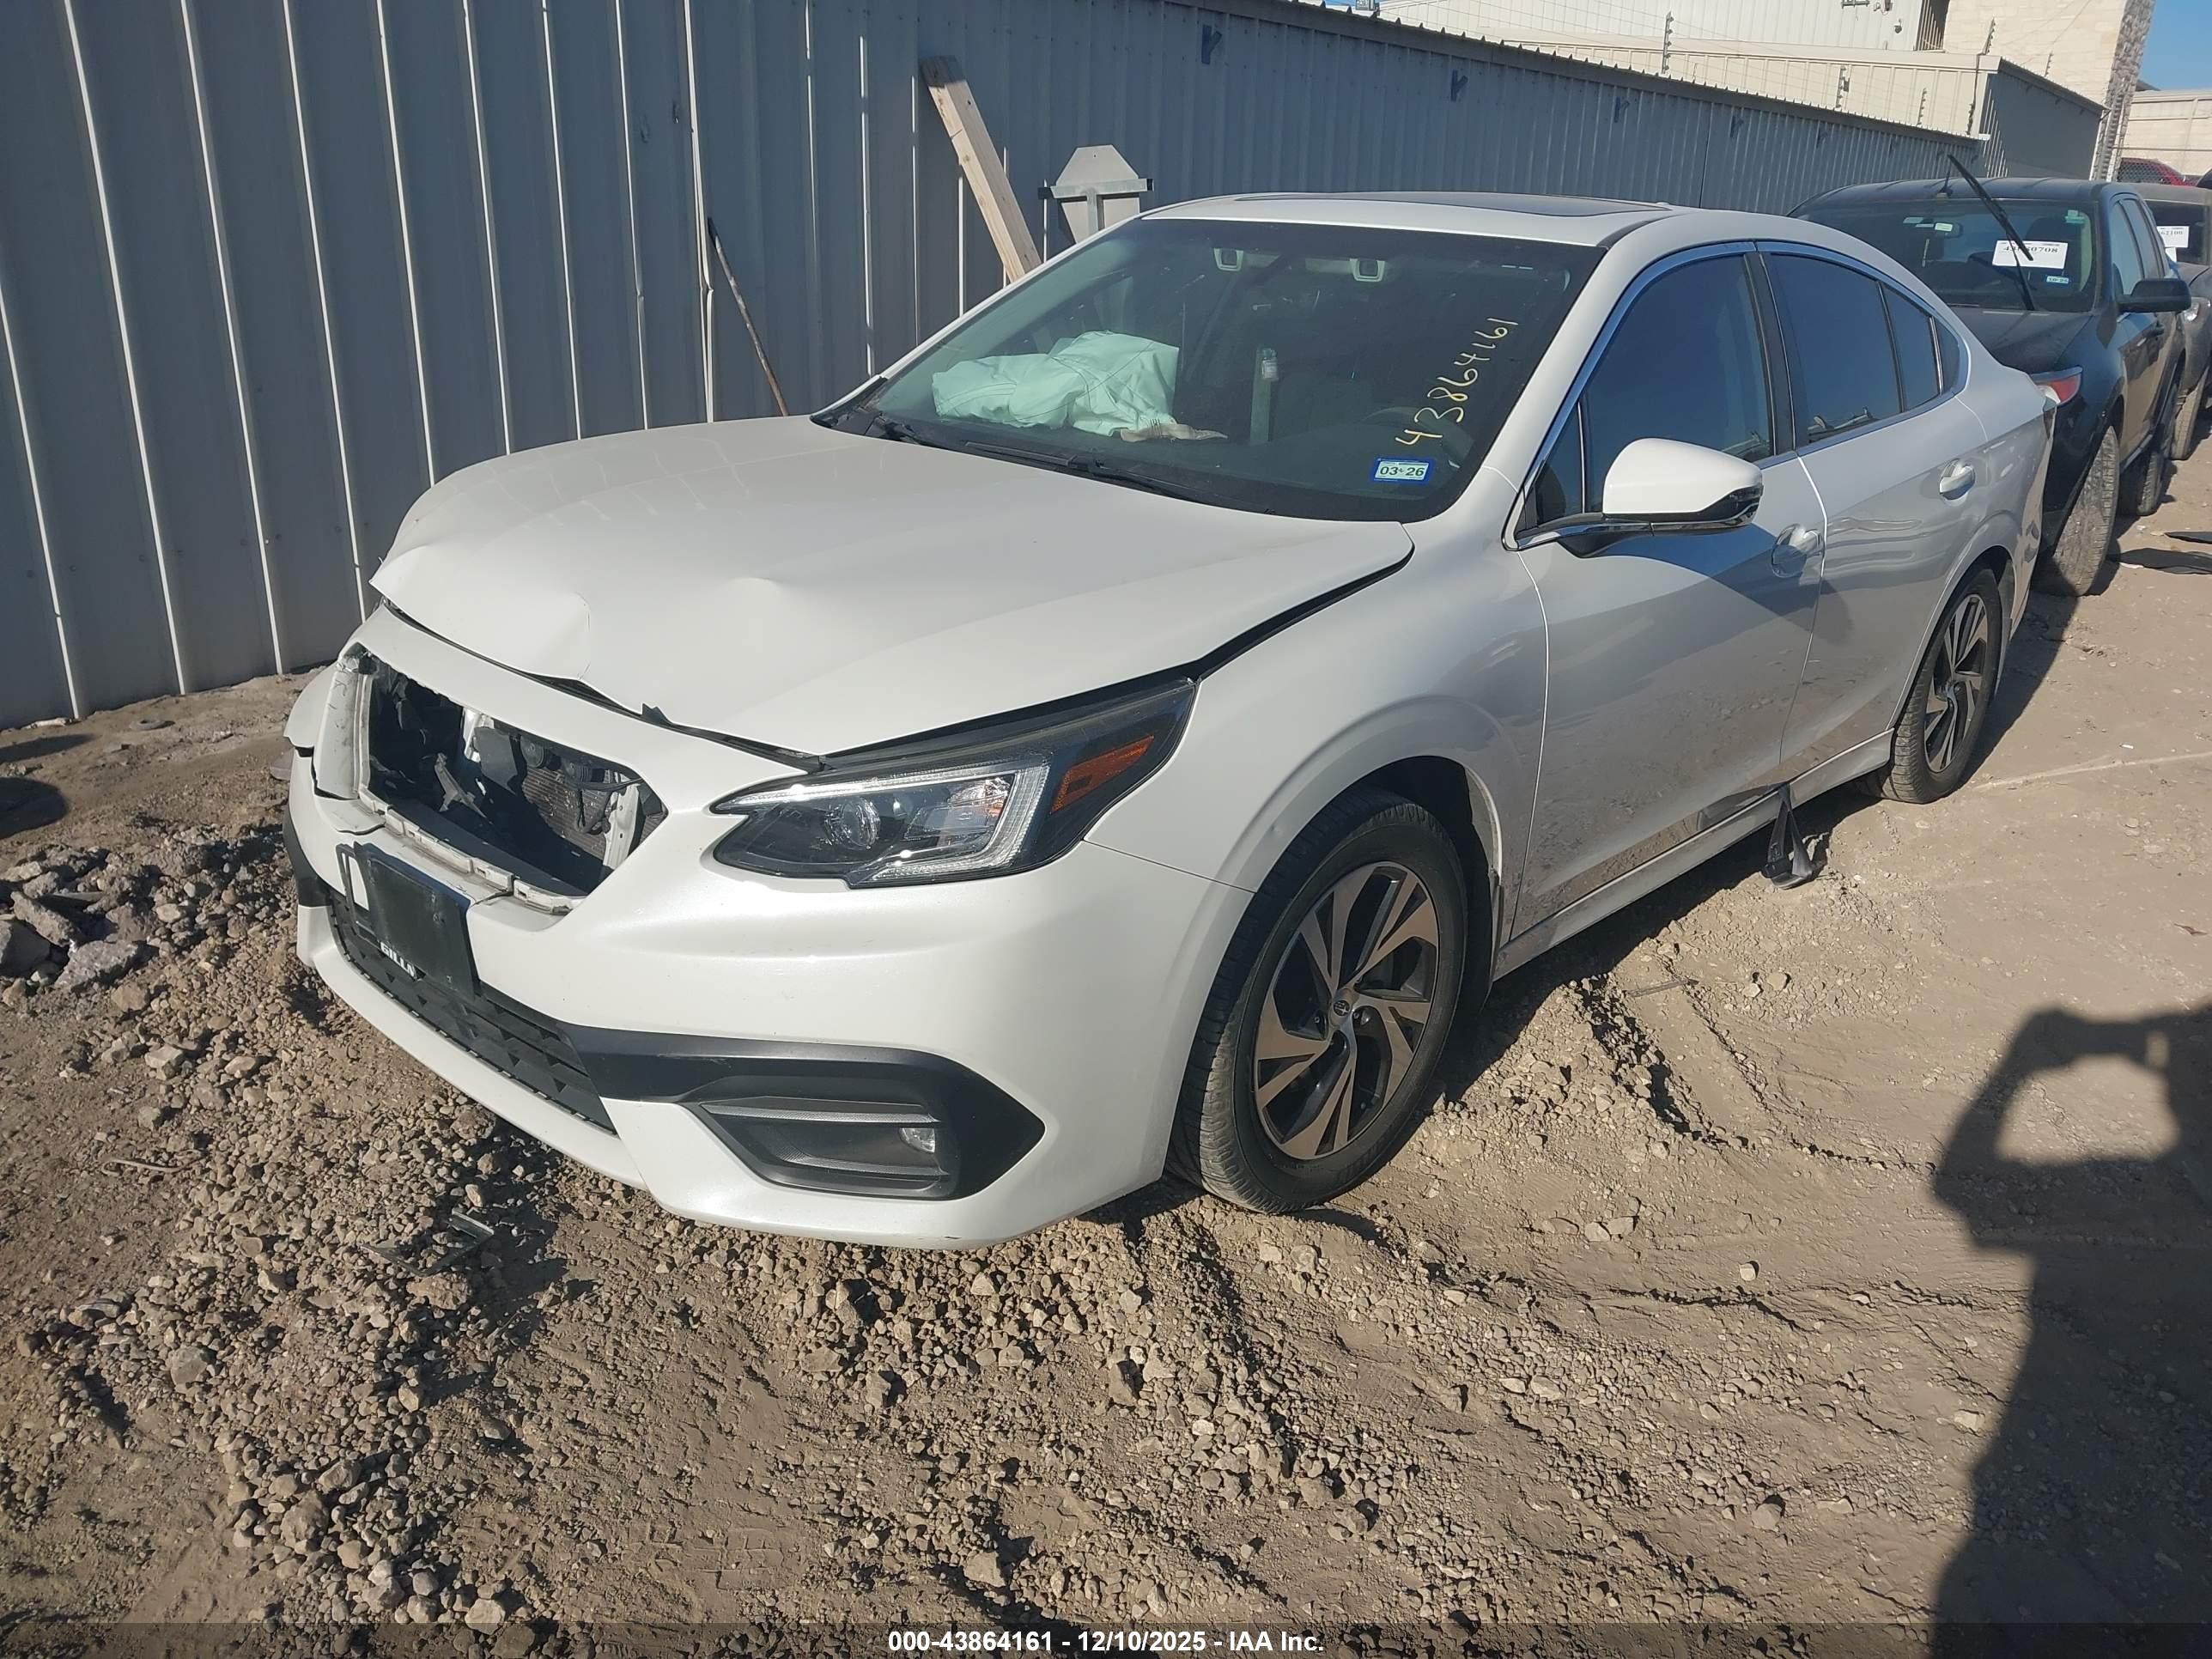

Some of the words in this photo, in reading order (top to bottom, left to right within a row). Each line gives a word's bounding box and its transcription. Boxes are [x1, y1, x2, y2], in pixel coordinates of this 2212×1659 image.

[1395, 317, 1519, 447] 43864161
[1380, 466, 1399, 476] 03
[1405, 467, 1425, 477] 26
